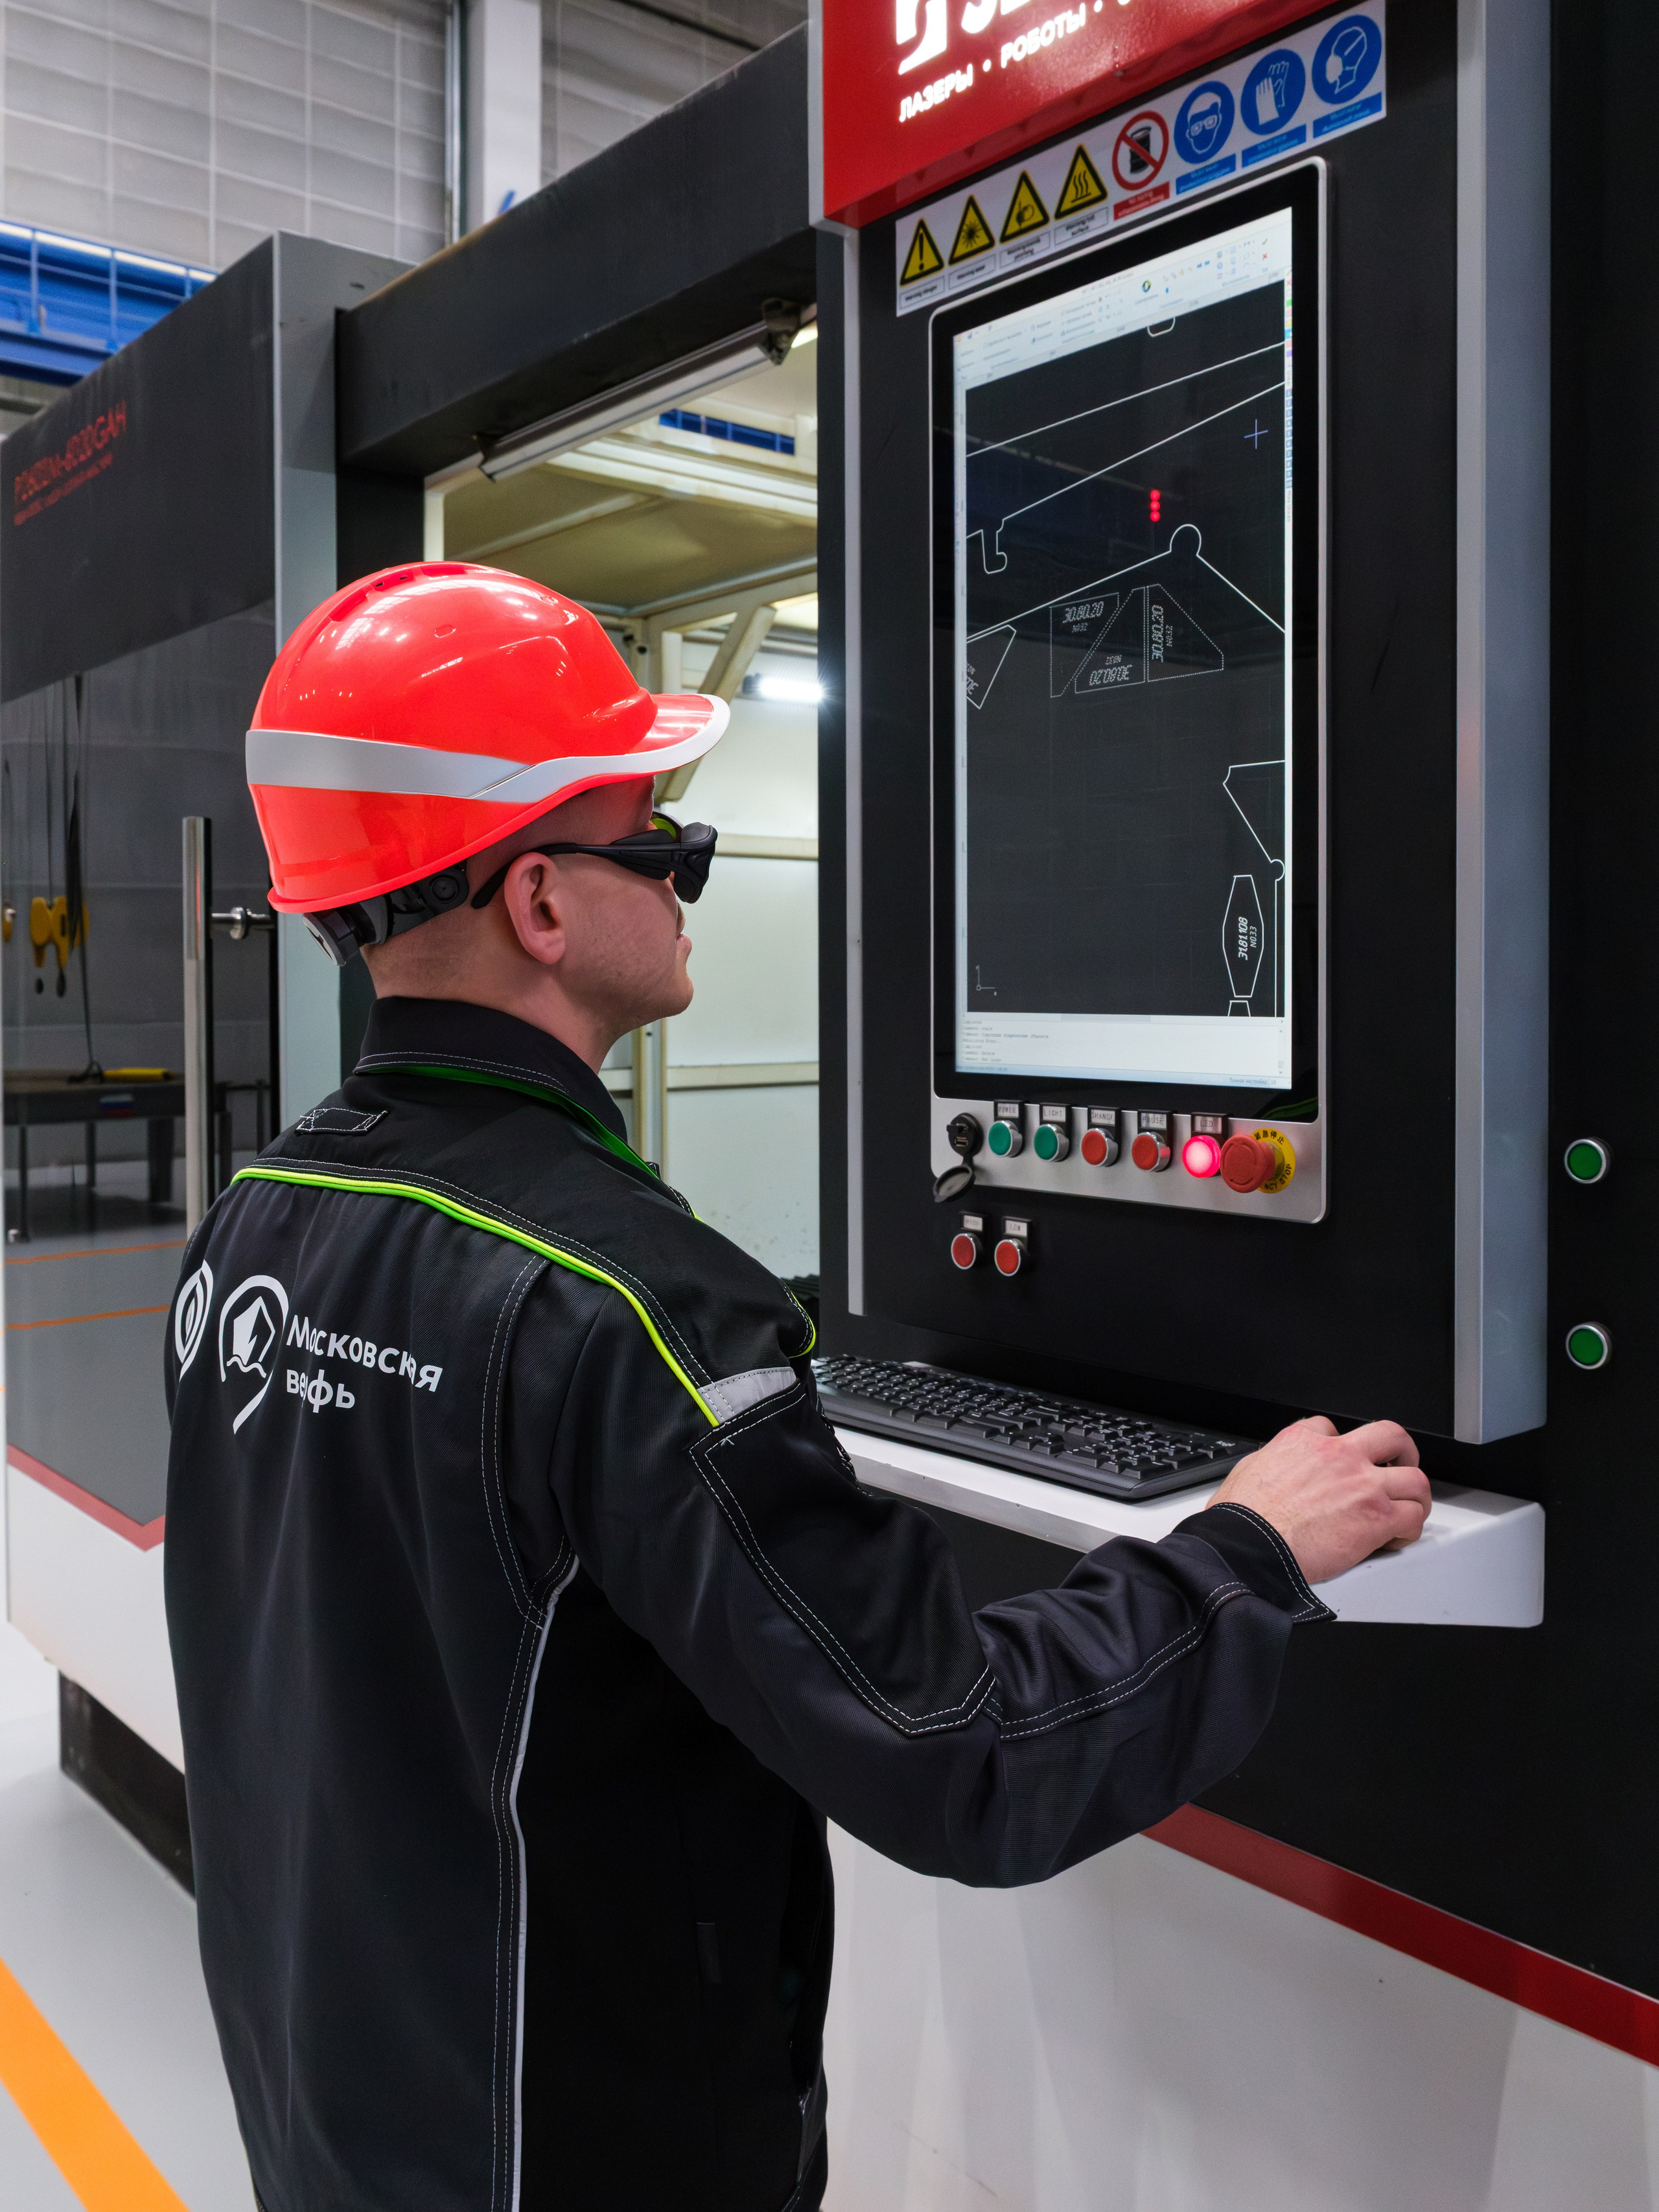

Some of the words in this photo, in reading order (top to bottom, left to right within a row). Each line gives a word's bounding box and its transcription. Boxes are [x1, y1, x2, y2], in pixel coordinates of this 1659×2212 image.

[898, 63, 973, 123] ЛАЗЕРЫ
[1000, 2, 1086, 69] РОБОТЫ
[1238, 916, 1248, 960] 31.81.108
[1279, 1163, 1293, 1185] STOP
[286, 1314, 444, 1393] Московская
